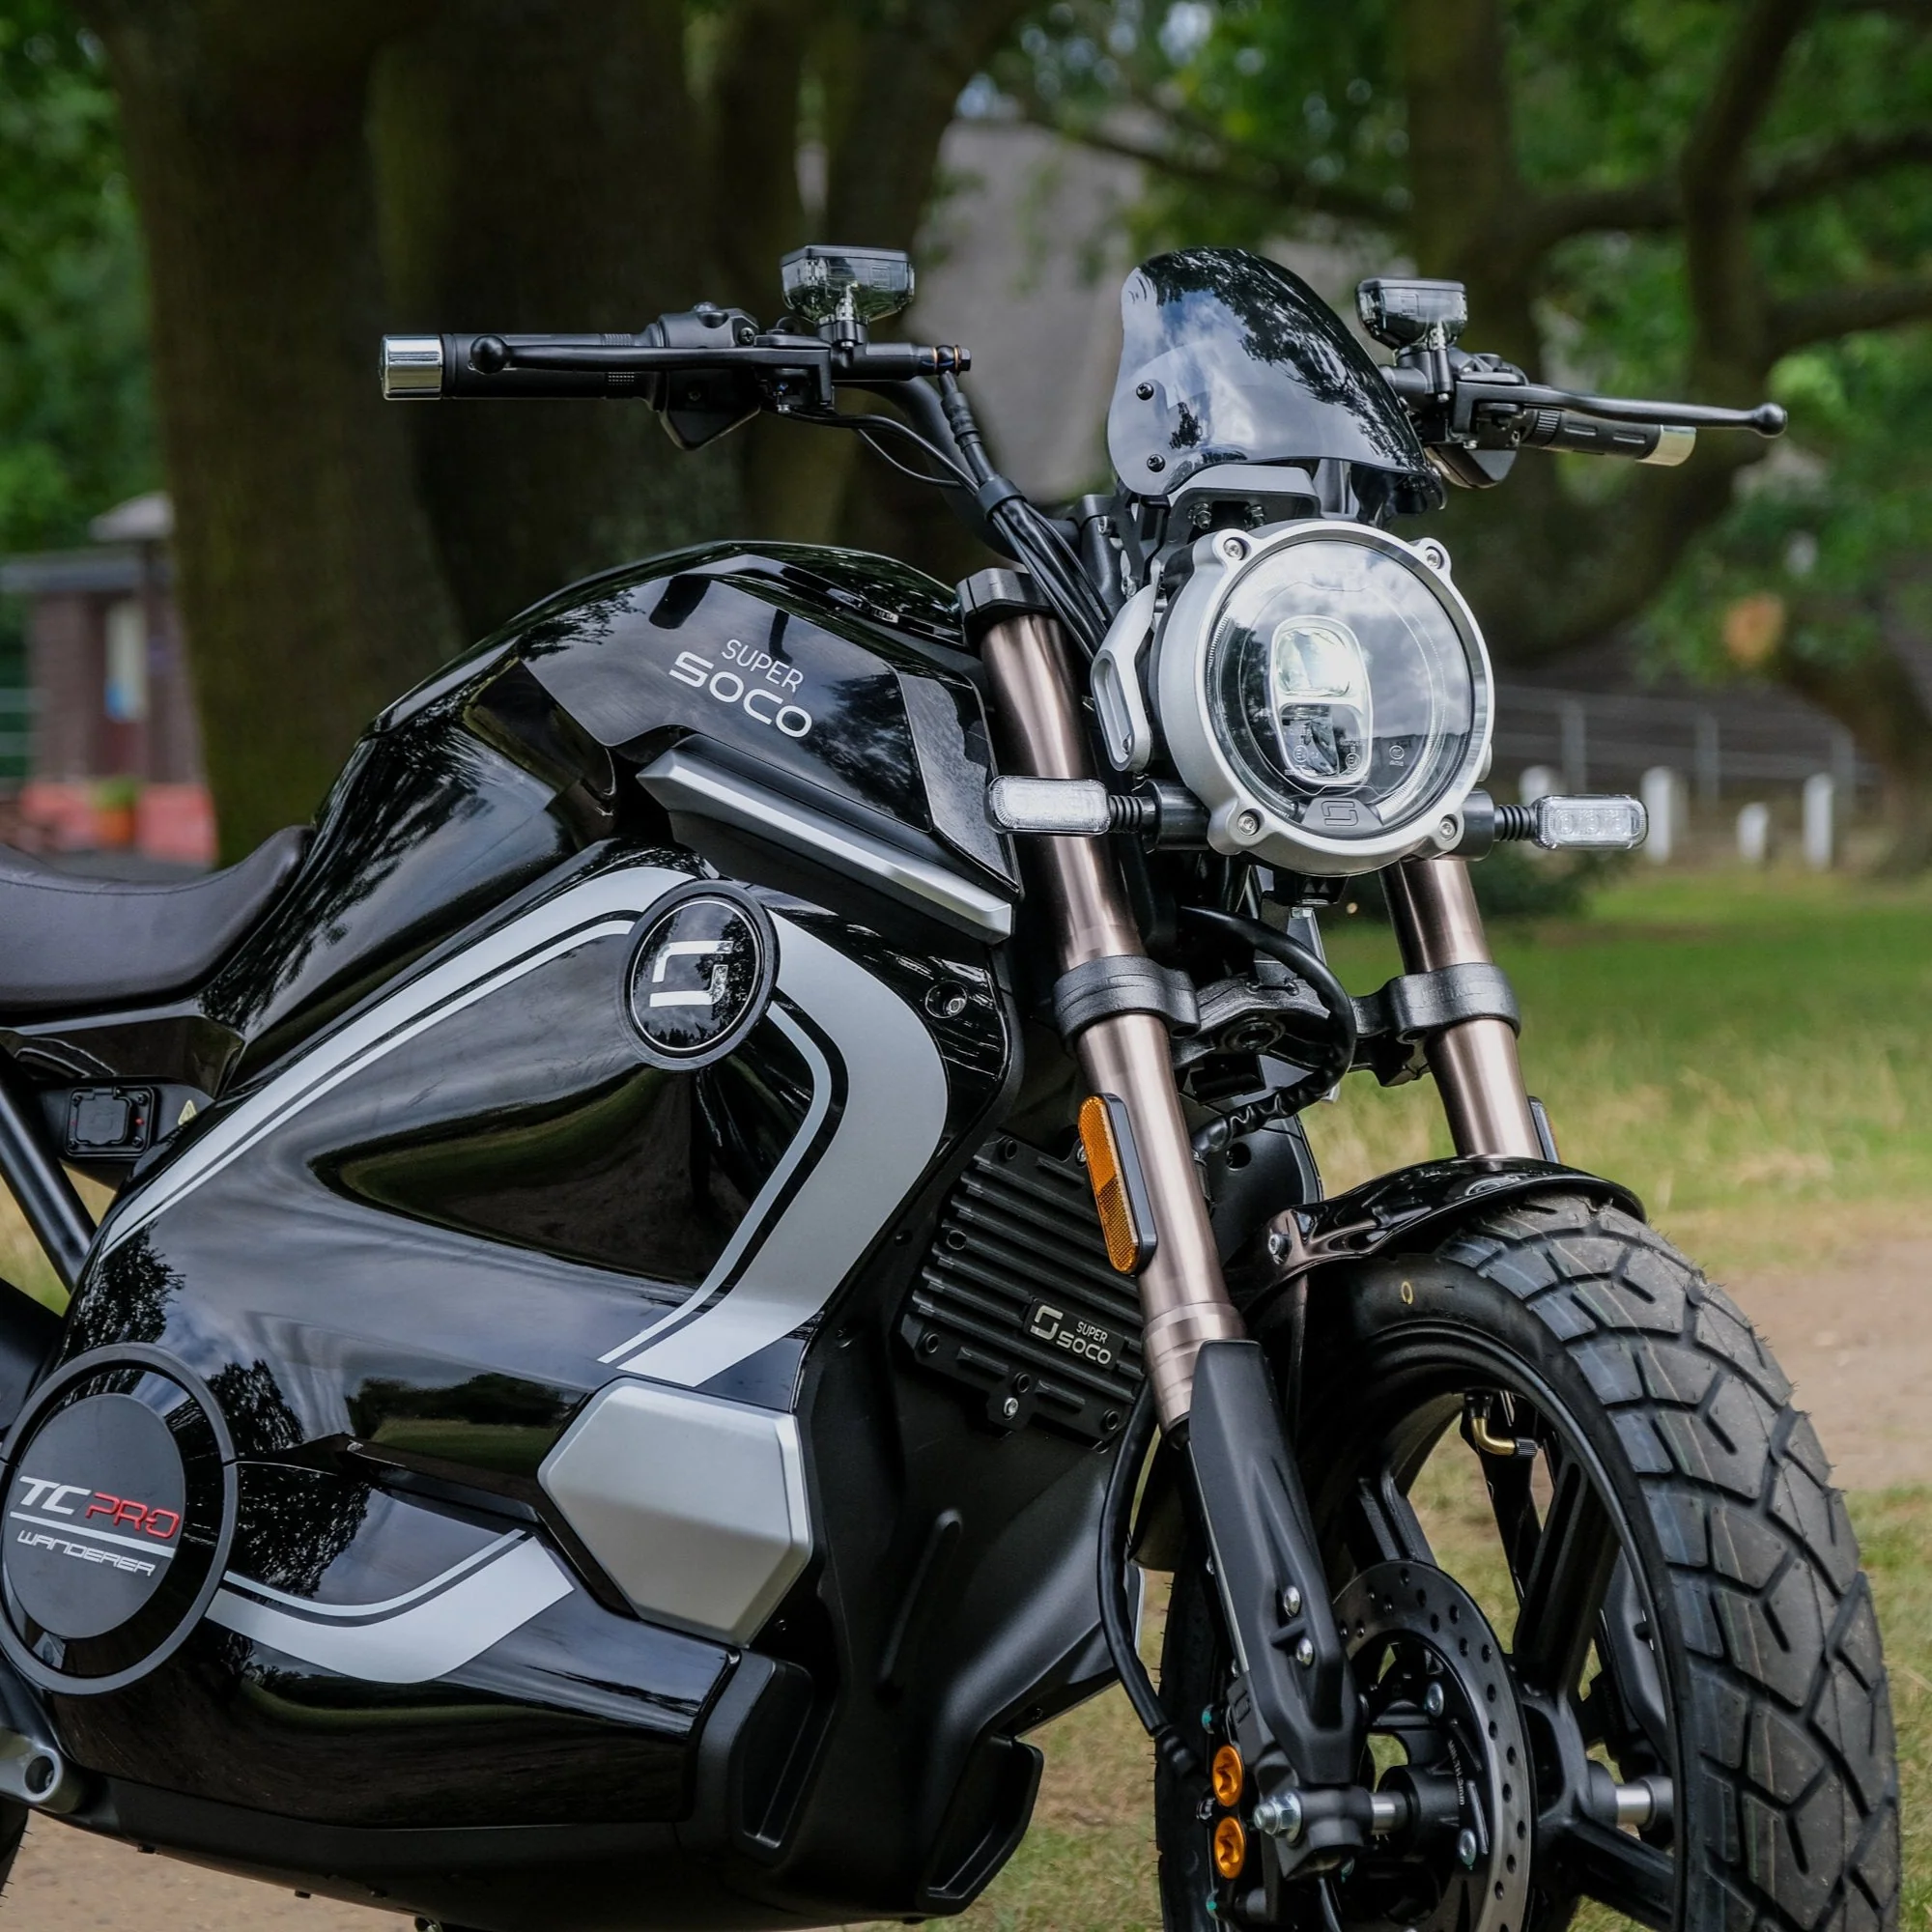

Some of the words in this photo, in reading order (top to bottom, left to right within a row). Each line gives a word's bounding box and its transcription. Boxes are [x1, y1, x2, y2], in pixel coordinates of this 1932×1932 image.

[722, 639, 804, 693] SUPER
[668, 651, 812, 738] SOCO
[1056, 1330, 1112, 1365] SOCO
[1076, 1321, 1108, 1344] SUPER
[19, 1475, 92, 1516] TC
[85, 1492, 180, 1540] PRO
[16, 1529, 156, 1577] WANDERER
